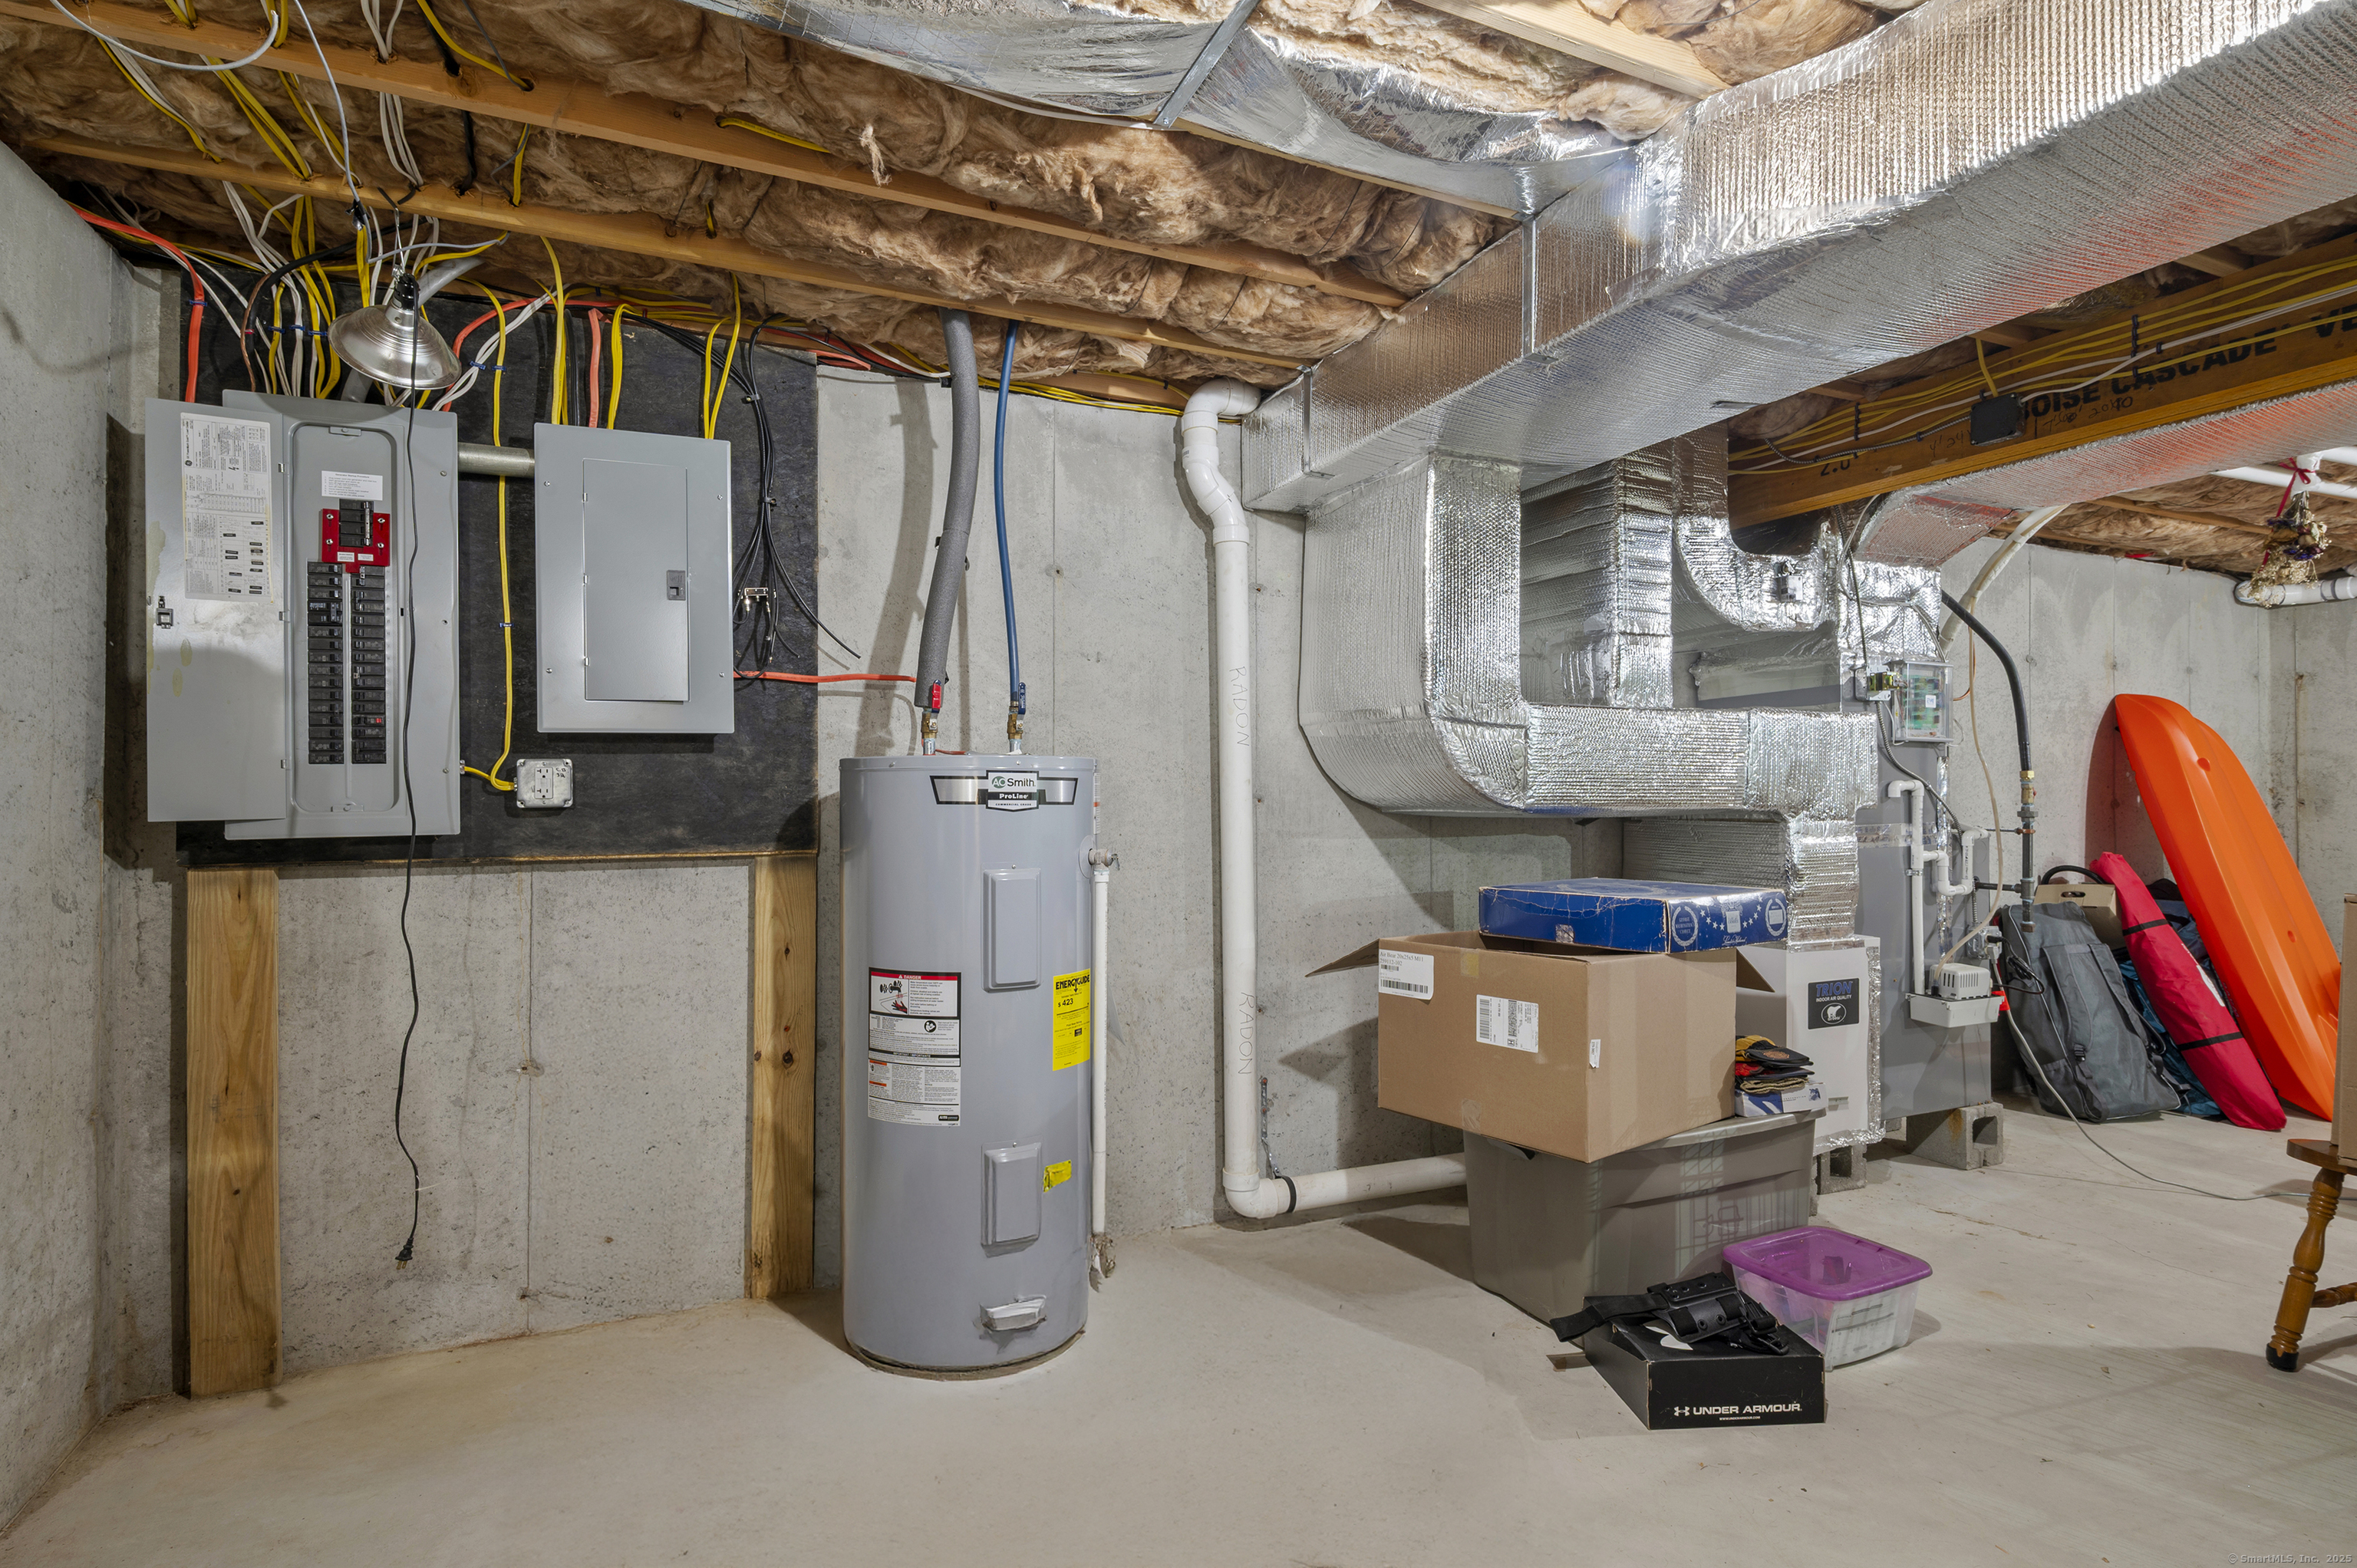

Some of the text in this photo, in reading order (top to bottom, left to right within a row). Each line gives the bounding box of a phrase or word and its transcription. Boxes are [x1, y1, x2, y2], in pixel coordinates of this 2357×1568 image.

[2111, 328, 2278, 394] CASCADE
[1229, 666, 1250, 746] RADON
[1007, 778, 1035, 787] Smith
[1815, 981, 1852, 997] TRION
[1238, 992, 1255, 1074] RADON
[1693, 1403, 1802, 1415] UNDER ARMOUR
